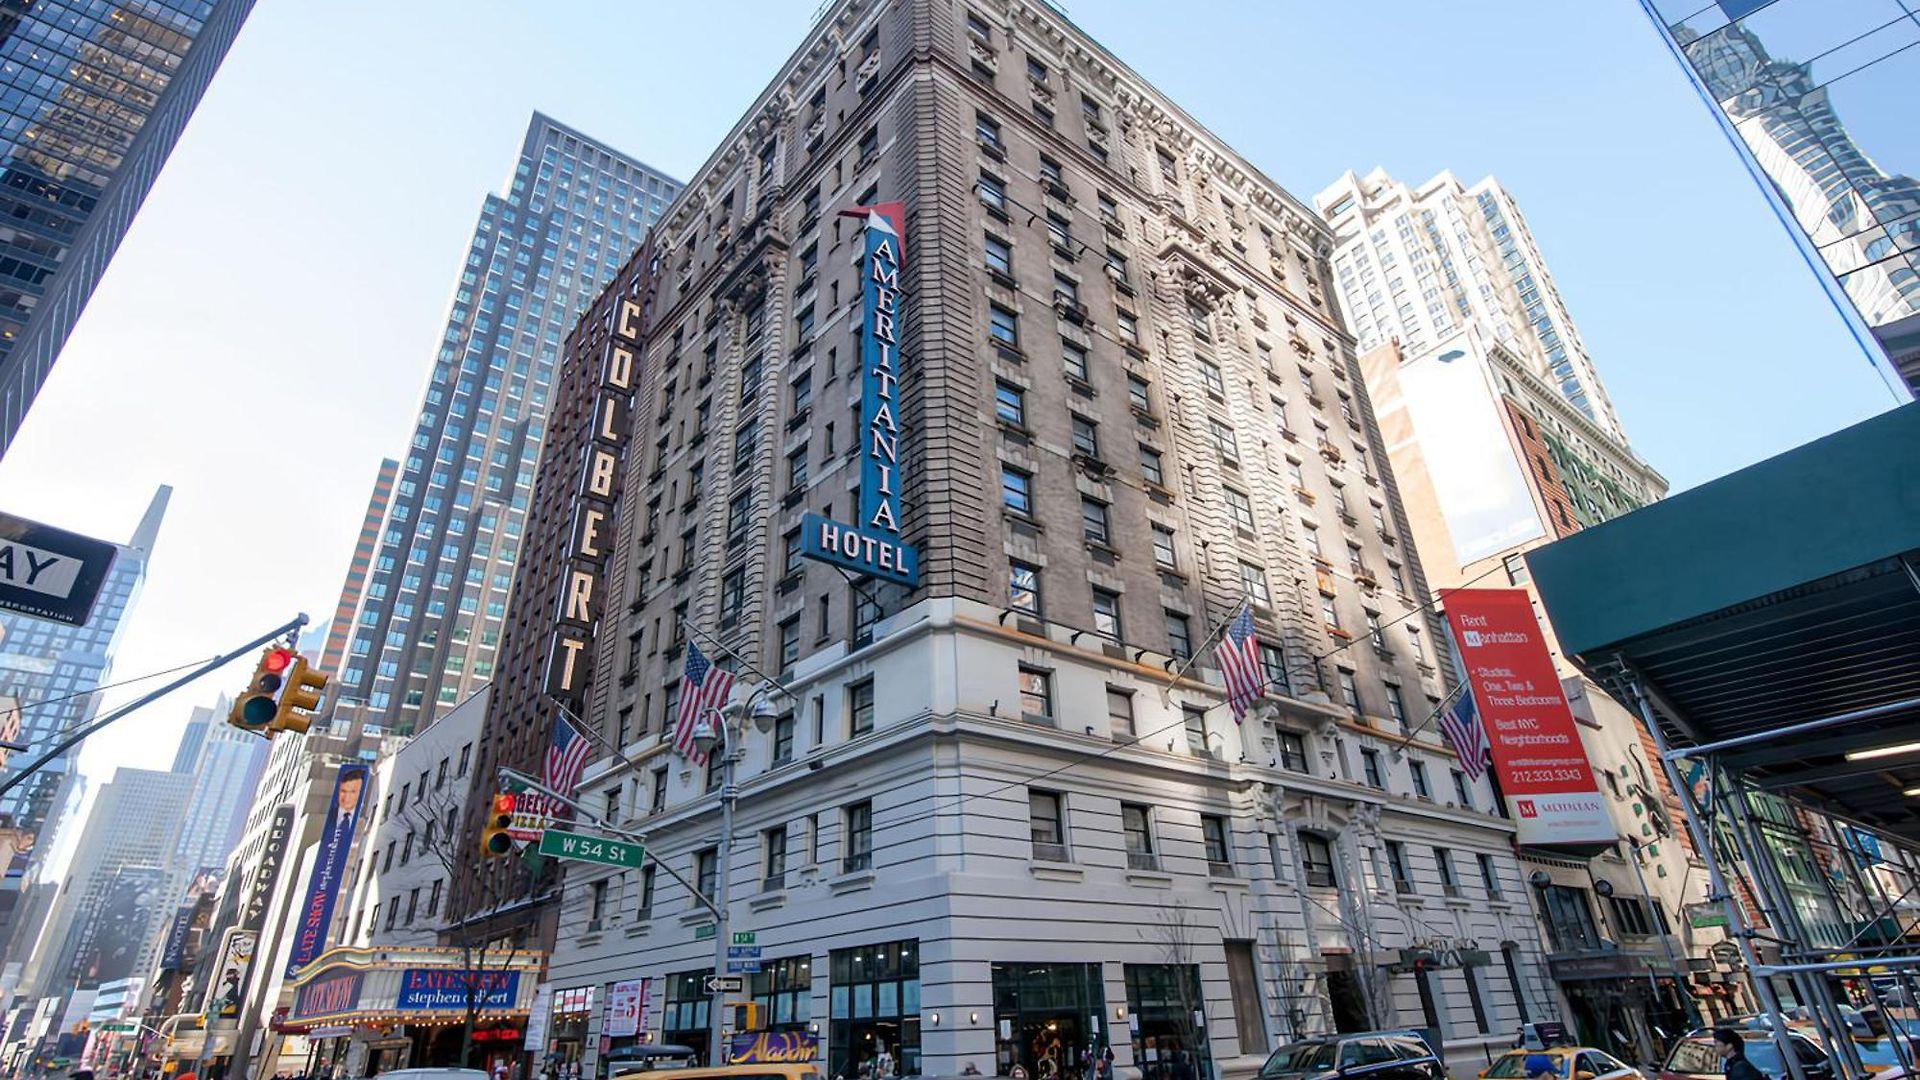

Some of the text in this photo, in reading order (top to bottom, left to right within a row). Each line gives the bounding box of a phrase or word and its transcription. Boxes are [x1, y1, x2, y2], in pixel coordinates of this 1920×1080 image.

[871, 239, 900, 533] AMERITANIA
[560, 300, 640, 690] COLBERT
[821, 523, 910, 574] HOTEL
[1460, 615, 1487, 626] Rent
[1465, 631, 1528, 644] Manhattan
[1488, 695, 1562, 706] Three Bedrooms
[1495, 719, 1539, 730] Best NYC
[1500, 734, 1569, 747] Neighborhoods
[563, 838, 626, 862] W 54 St
[249, 817, 288, 921] BROADWAY
[306, 890, 327, 929] SHOW
[297, 929, 317, 963] LATE
[407, 989, 460, 1008] stephen
[730, 1030, 818, 1063] Aladdin
